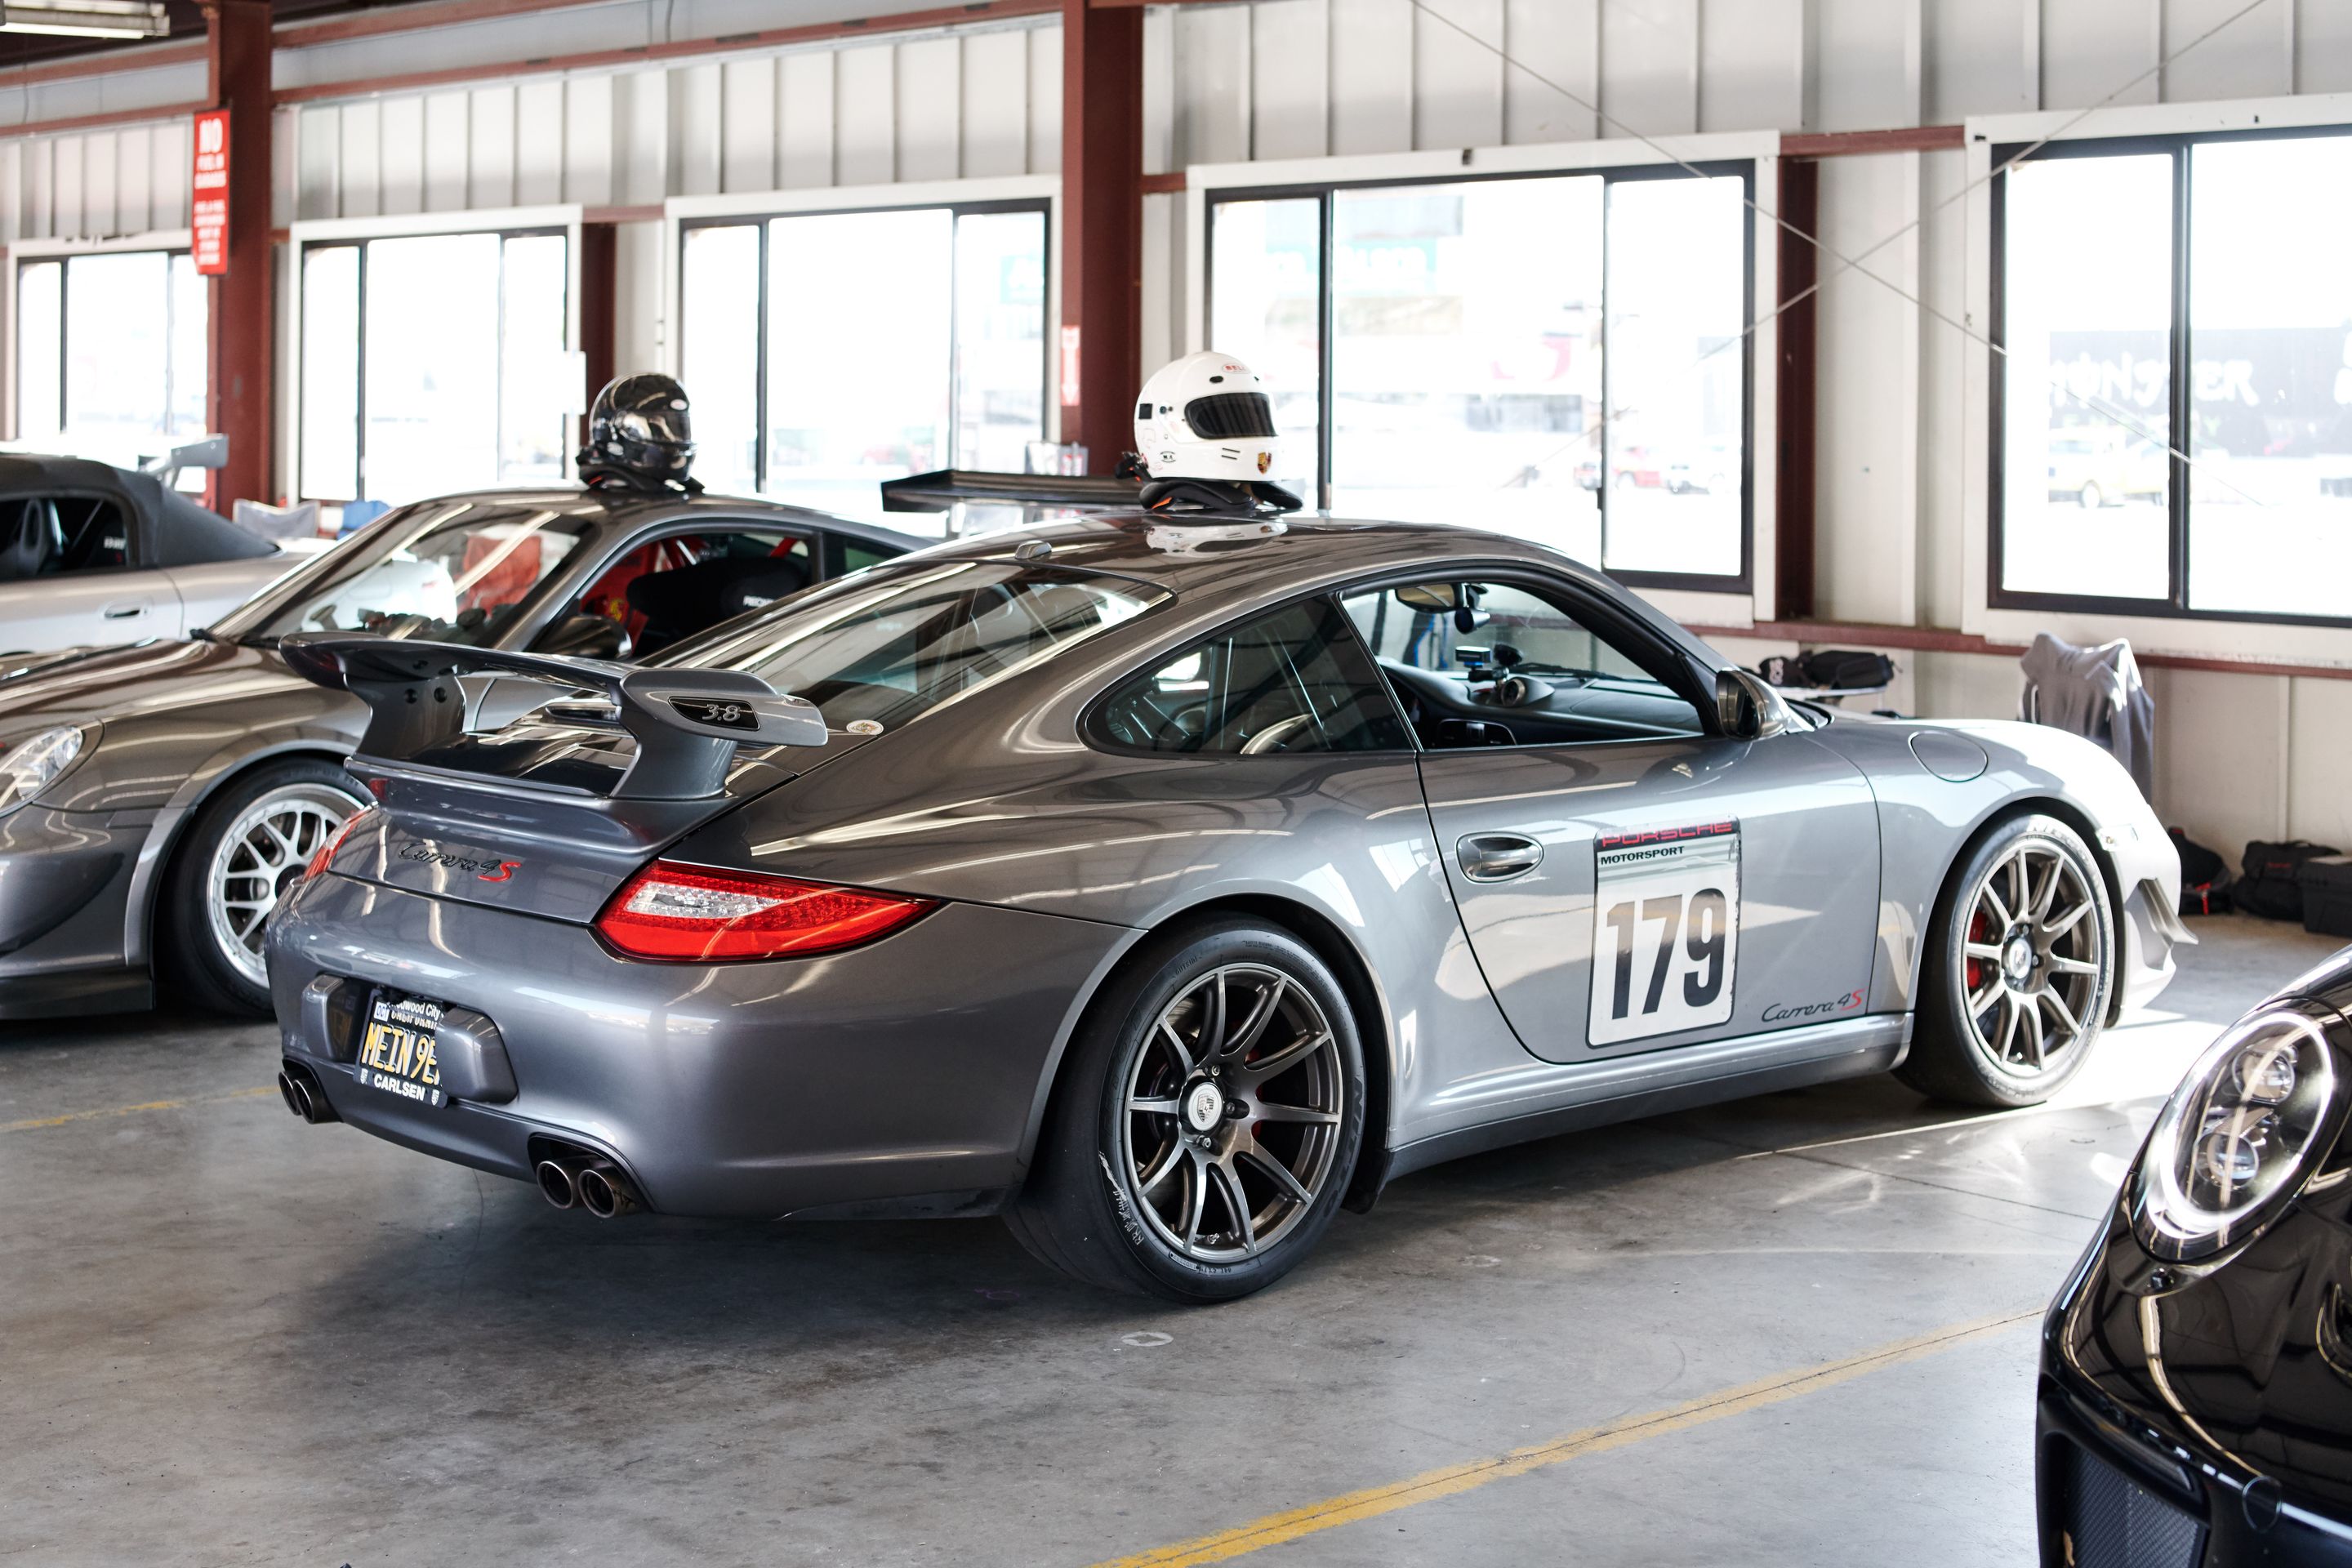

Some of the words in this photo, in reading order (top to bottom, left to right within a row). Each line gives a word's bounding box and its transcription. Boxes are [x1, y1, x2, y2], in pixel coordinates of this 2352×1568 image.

[199, 118, 222, 154] NO
[2050, 351, 2261, 408] MONSER
[702, 704, 741, 722] 3.8
[1601, 822, 1732, 848] PORSCHE
[399, 842, 479, 871] Carrera
[478, 859, 522, 882] 4S
[1601, 846, 1685, 865] MOTORSPORT
[1606, 888, 1727, 1020] 179
[425, 1003, 441, 1021] City
[1762, 1002, 1834, 1022] Carrera
[1838, 987, 1868, 1011] 4S
[361, 1022, 416, 1076] MEIN
[374, 1073, 425, 1101] CARLSEN
